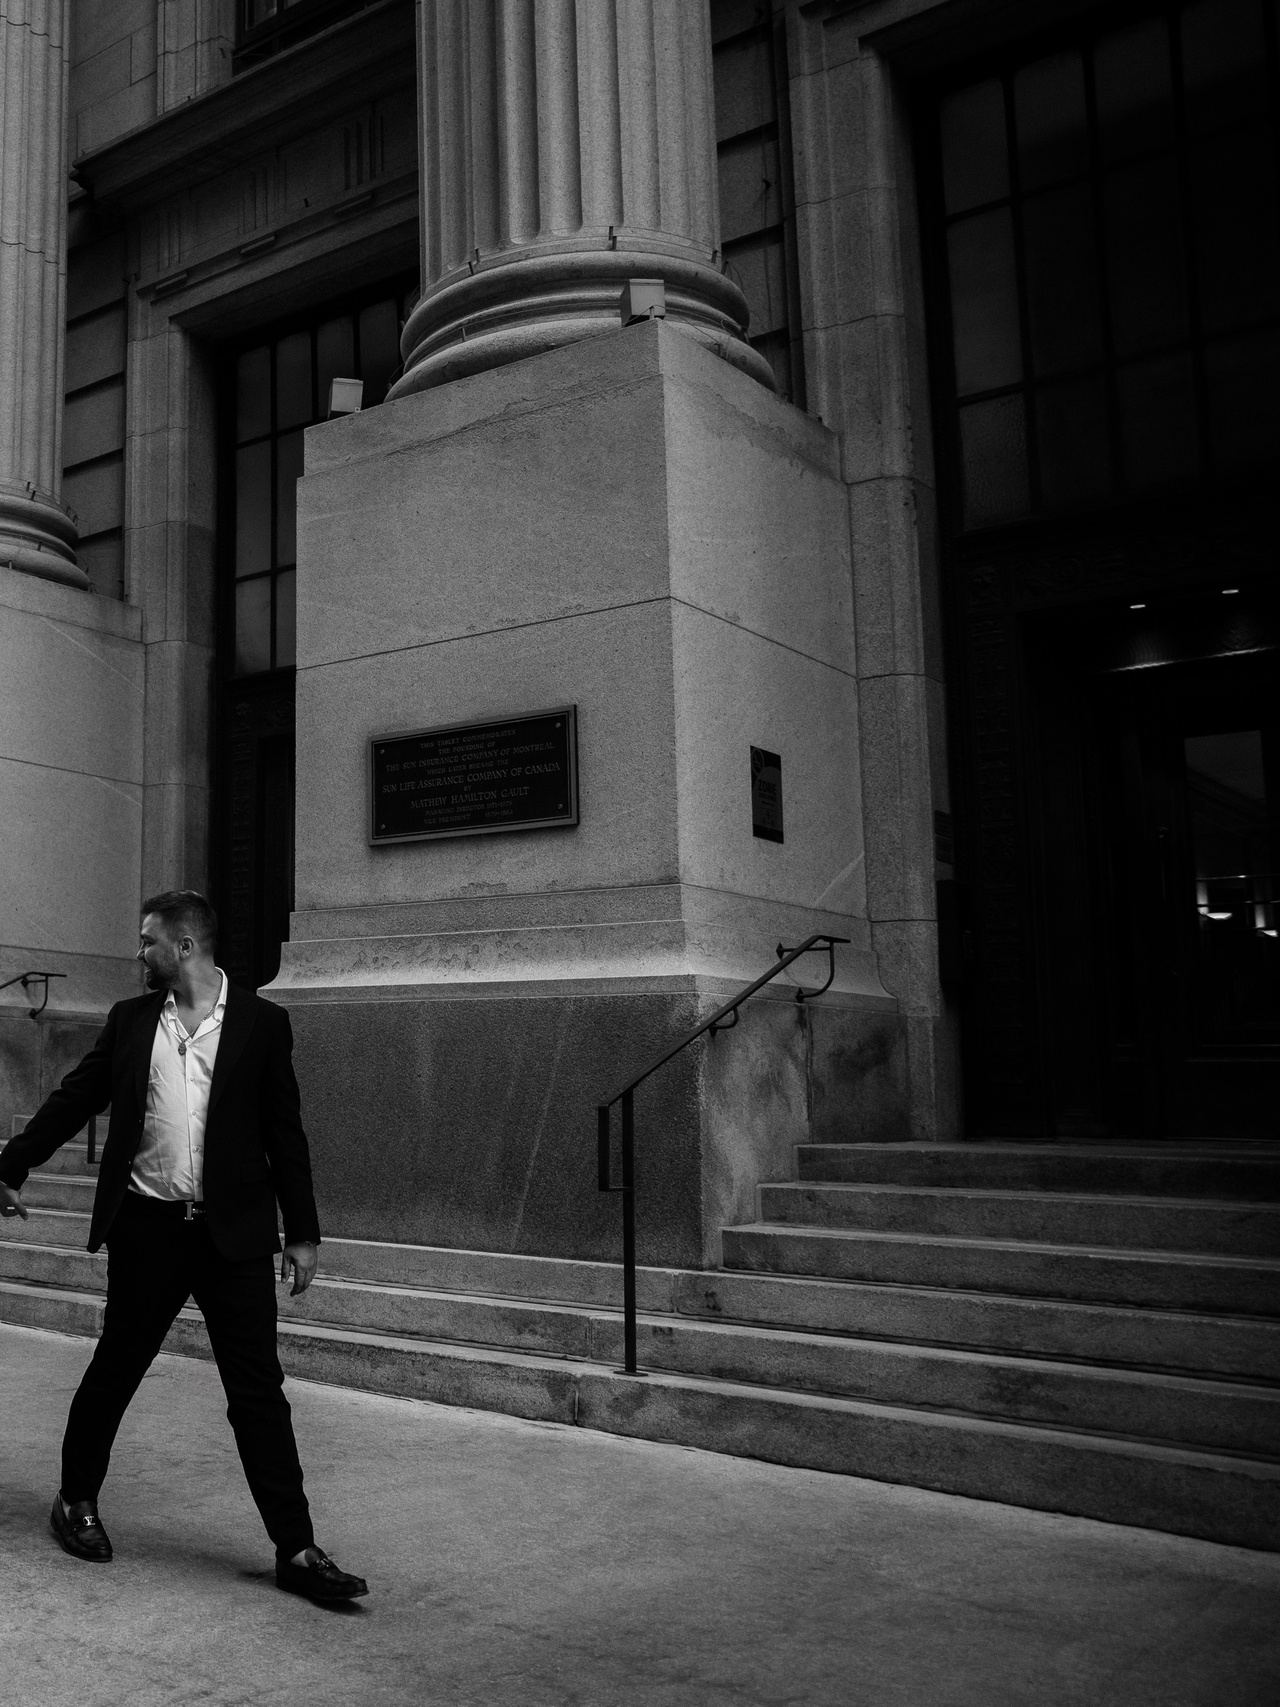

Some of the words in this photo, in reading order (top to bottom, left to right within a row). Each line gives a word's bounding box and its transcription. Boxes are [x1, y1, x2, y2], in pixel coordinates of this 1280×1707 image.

[437, 737, 460, 747] TABLET
[452, 742, 484, 752] FOUNDING
[385, 764, 400, 772] THE
[402, 761, 417, 770] SUN
[418, 755, 459, 768] INSURANCE
[461, 750, 498, 761] COMPANY
[500, 748, 511, 756] OF
[513, 742, 555, 755] MONTREAL
[382, 783, 397, 793] SUN
[399, 781, 416, 791] LIFE
[417, 775, 464, 789] ASSURANCE
[466, 769, 509, 782] COMPANY
[510, 767, 523, 777] OF
[524, 762, 561, 775] CANADA
[758, 779, 776, 796] ZONE
[410, 796, 447, 809] MATHEW
[451, 790, 497, 804] HAMILTON
[500, 786, 530, 798] GAULT
